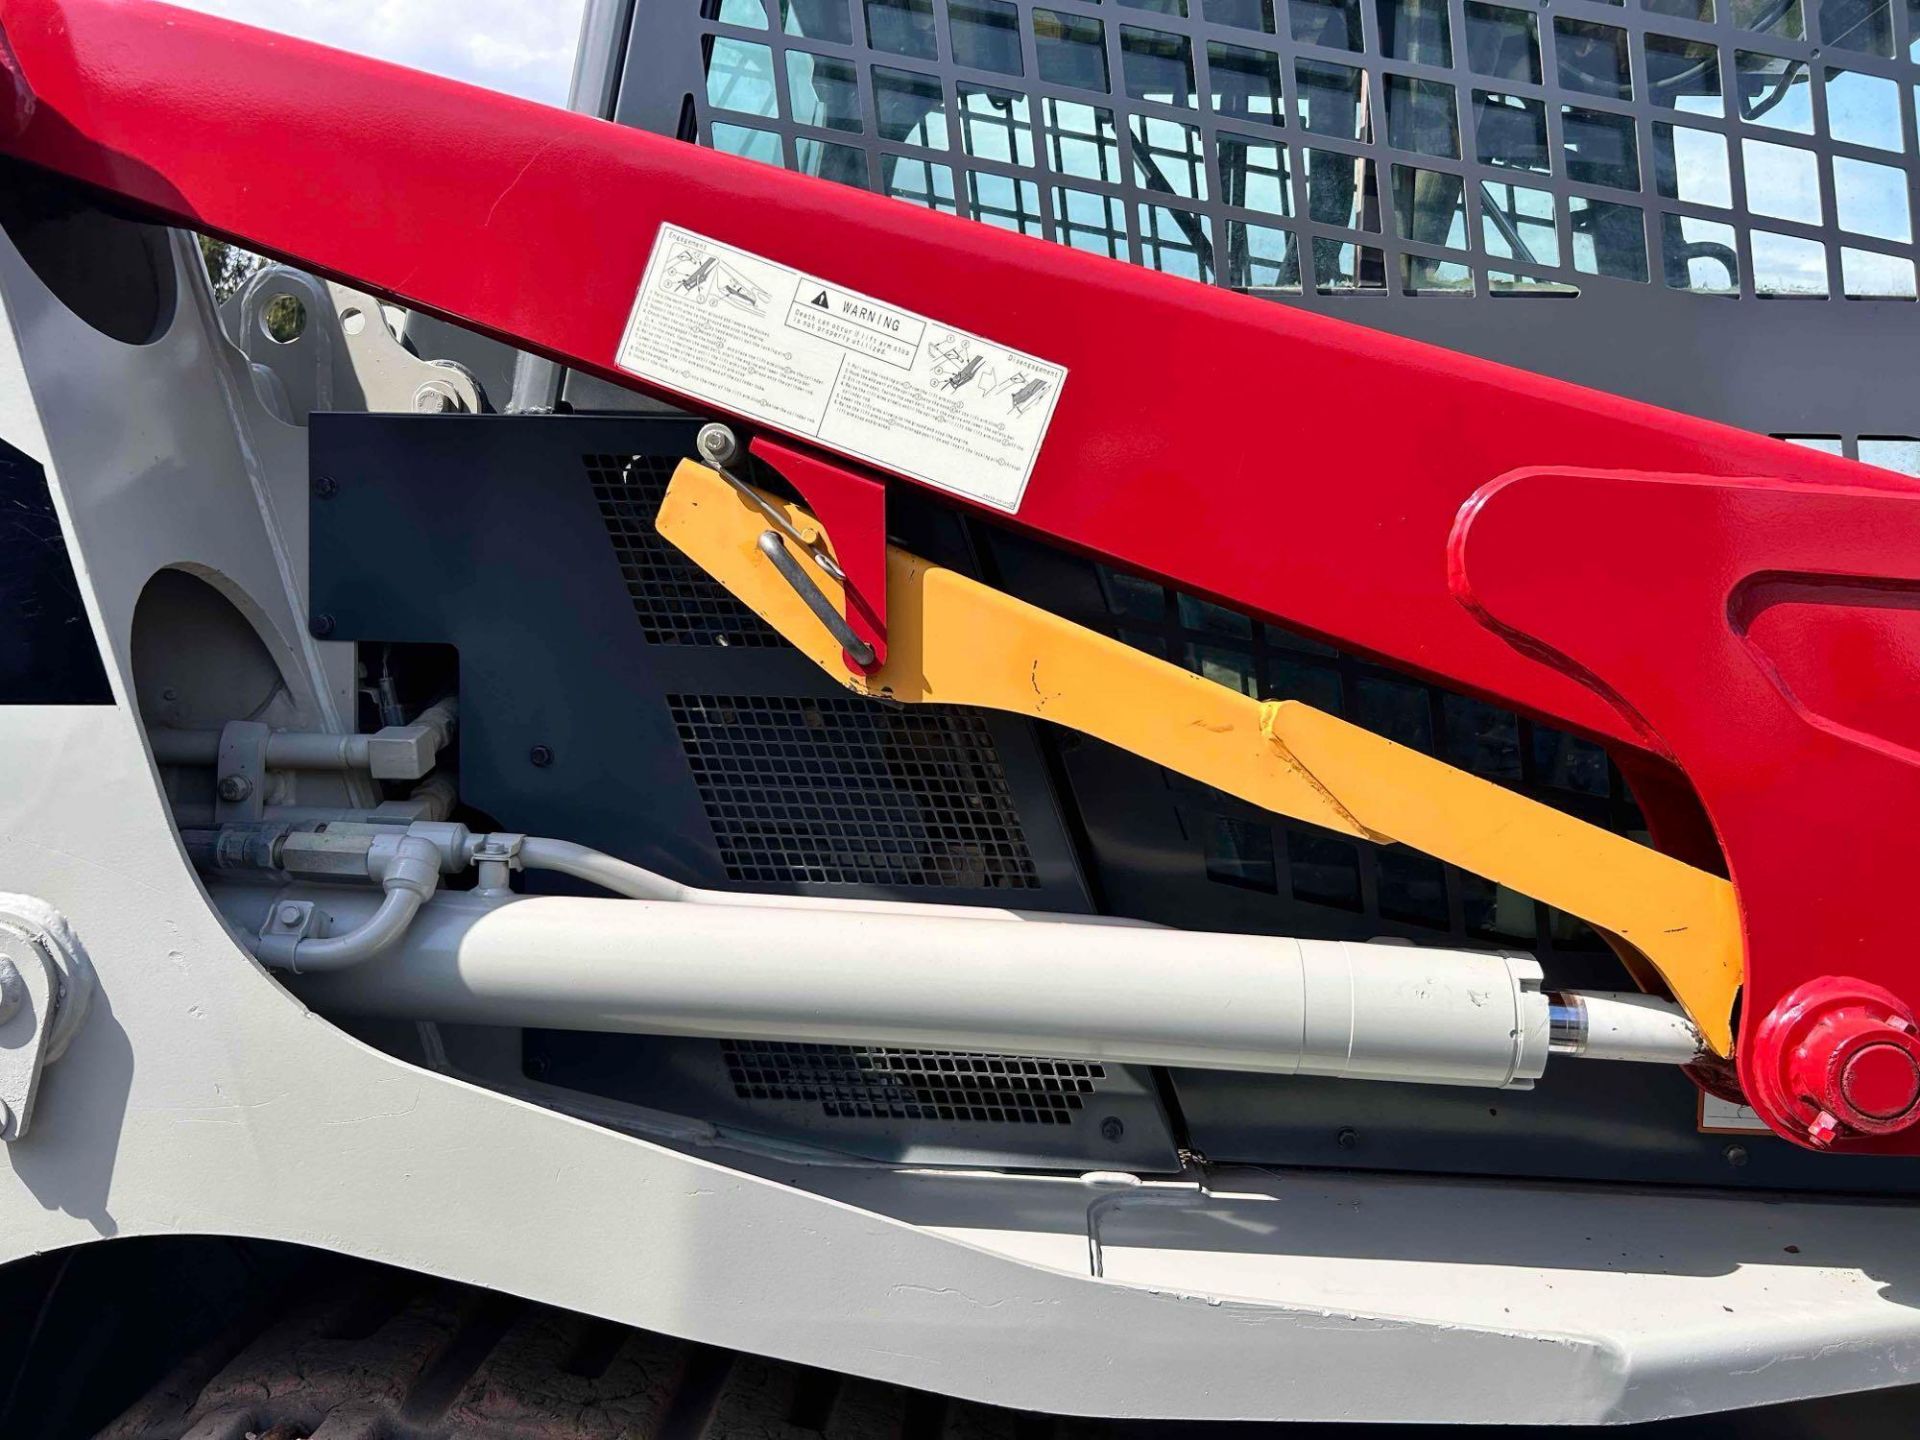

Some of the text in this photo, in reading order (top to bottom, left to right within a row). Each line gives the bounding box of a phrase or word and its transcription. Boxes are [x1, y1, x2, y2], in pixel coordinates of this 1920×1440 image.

[668, 231, 707, 250] Engagement
[792, 316, 801, 324] is
[801, 319, 815, 329] not
[816, 325, 850, 343] properly
[841, 300, 901, 332] WARNING
[794, 308, 816, 322] Death
[816, 317, 830, 327] can
[830, 322, 852, 335] occur
[860, 332, 877, 344] lift
[878, 339, 892, 350] arm
[893, 344, 910, 356] stop
[1007, 354, 1058, 378] Disengagement
